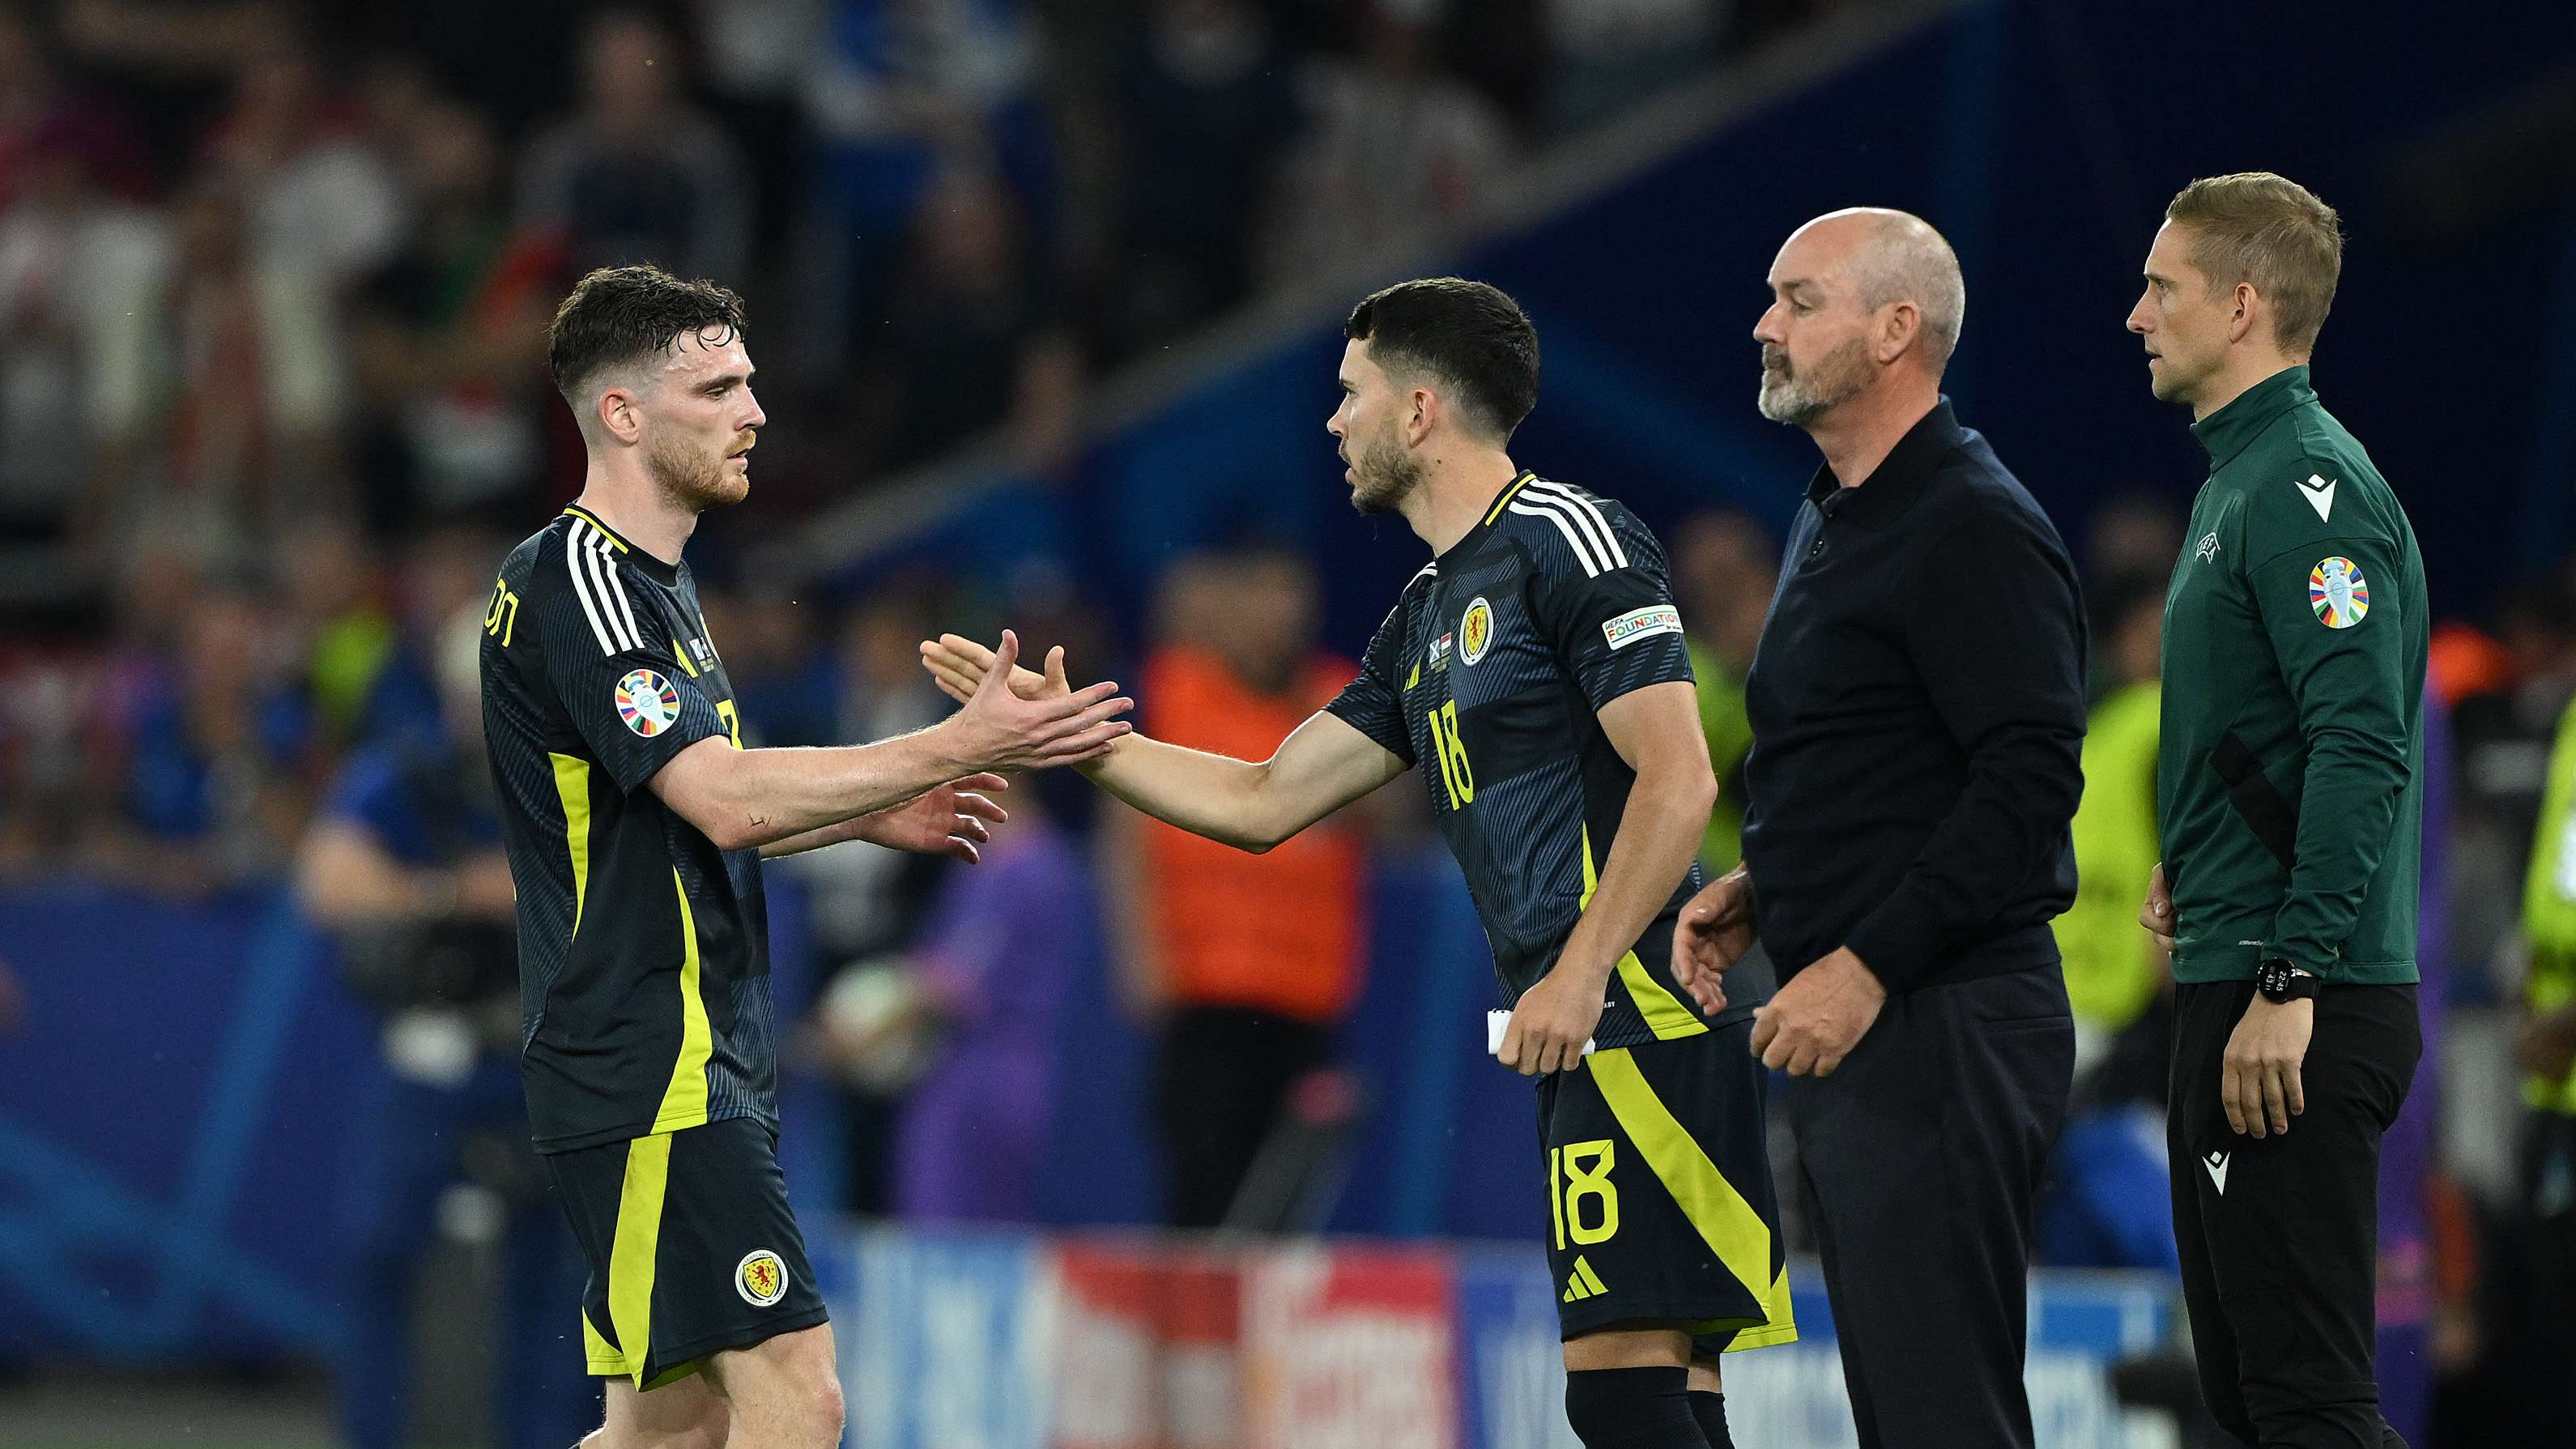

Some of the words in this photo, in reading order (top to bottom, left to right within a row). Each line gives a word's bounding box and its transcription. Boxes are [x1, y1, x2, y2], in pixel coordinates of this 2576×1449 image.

[1605, 618, 1624, 630] UEFA
[1429, 699, 1474, 811] 18
[1551, 1140, 1619, 1251] 18
